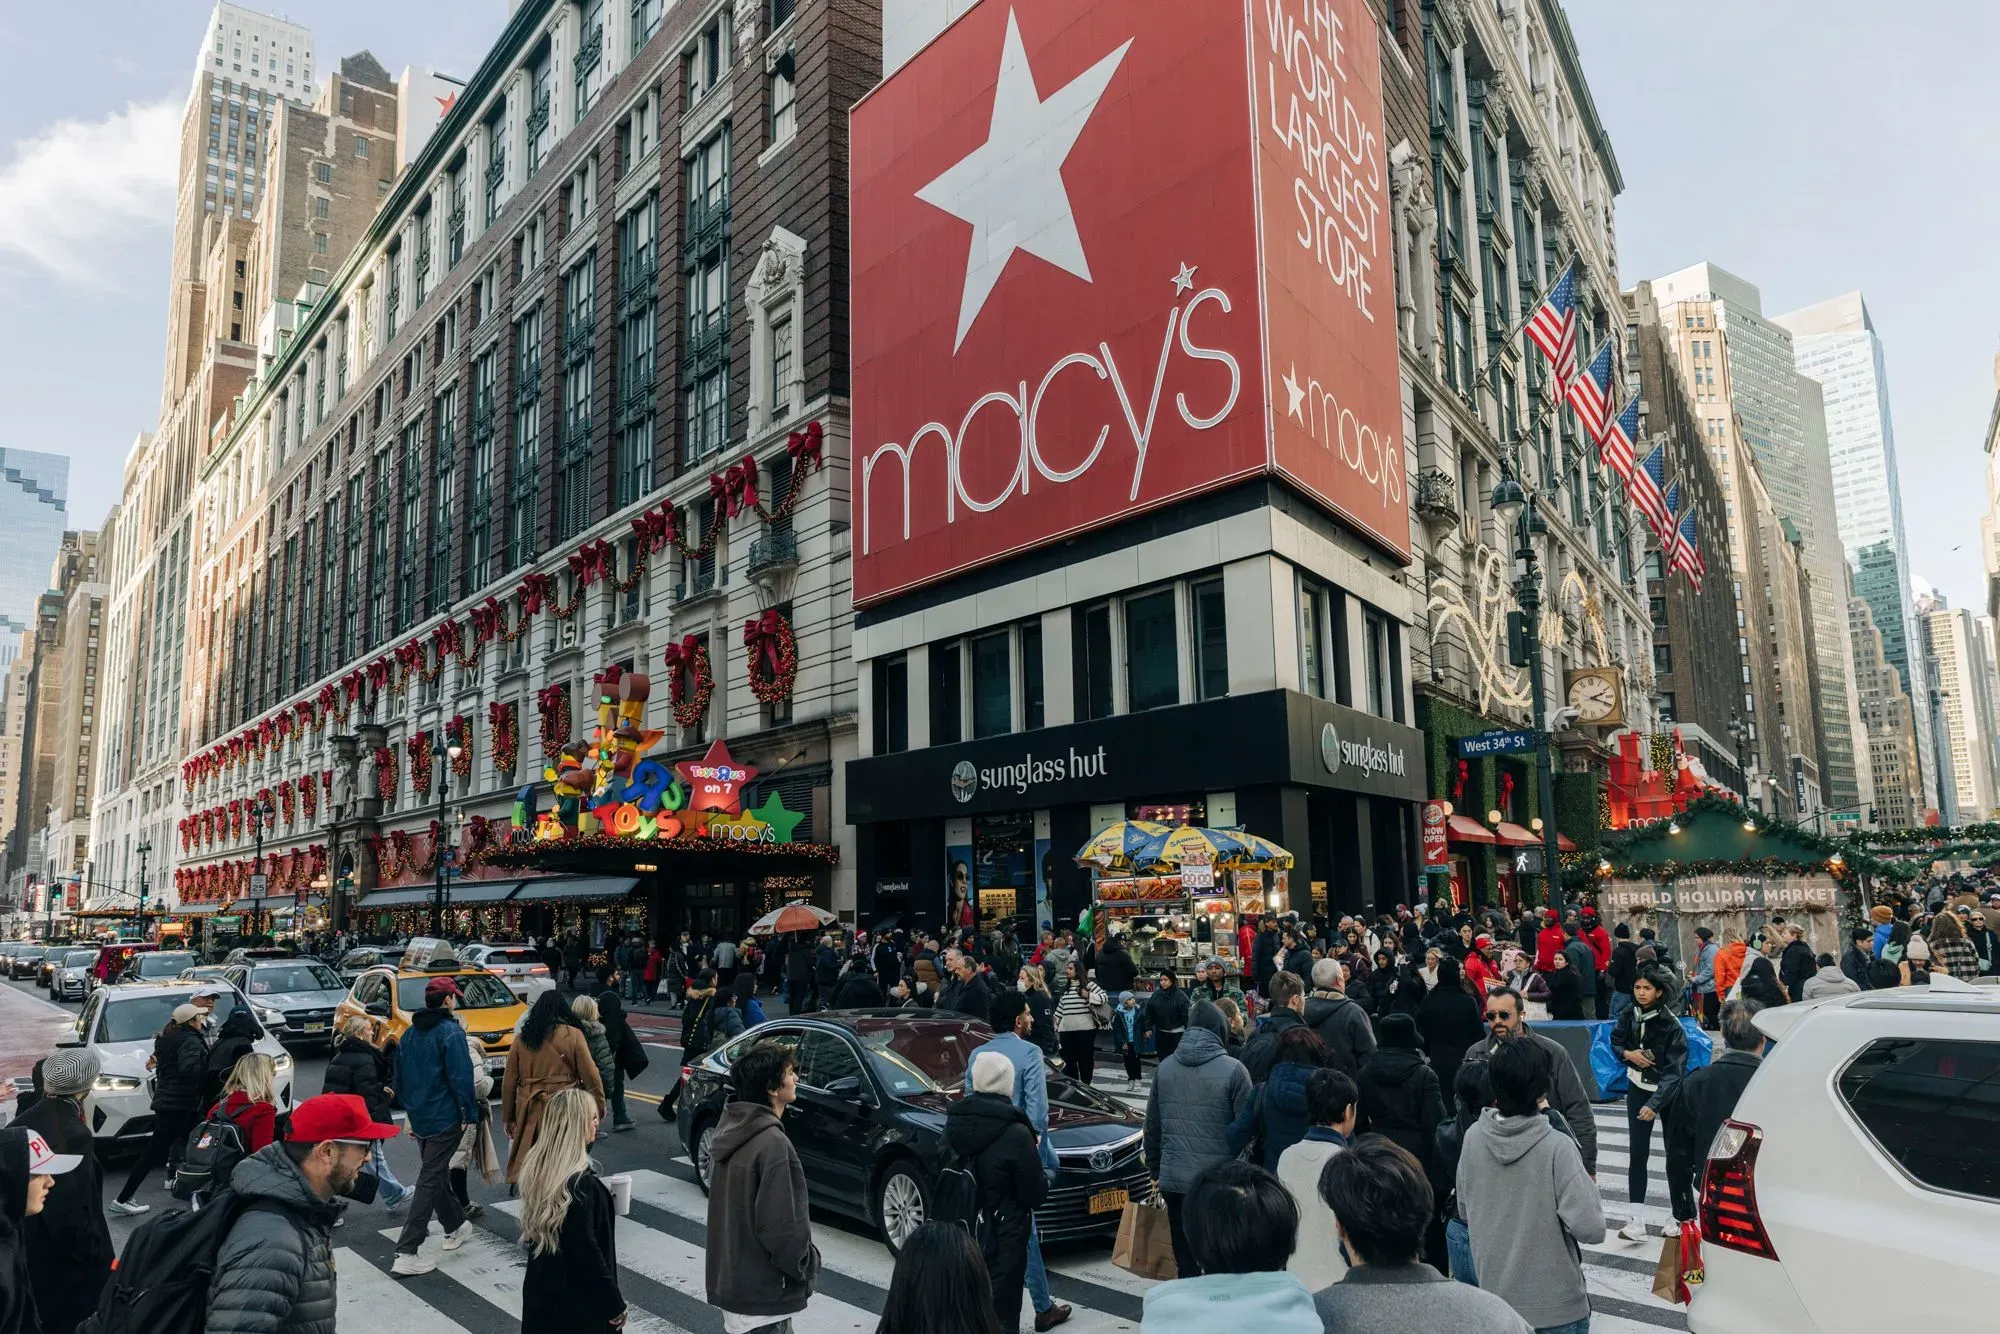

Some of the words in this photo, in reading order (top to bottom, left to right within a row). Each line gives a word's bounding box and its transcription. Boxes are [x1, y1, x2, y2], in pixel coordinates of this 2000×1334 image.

[1266, 0, 1379, 192] WORLD'S
[1269, 60, 1379, 258] LARGEST
[1294, 177, 1375, 323] STORE
[863, 262, 1240, 555] macy's
[1308, 376, 1400, 508] macy's
[1464, 740, 1491, 752] West
[1493, 736, 1512, 750] 34th
[1514, 735, 1526, 748] St
[1341, 736, 1388, 778] sunglass
[1387, 742, 1406, 777] hut
[980, 753, 1066, 795] sunglass
[1069, 745, 1108, 779] hut
[704, 784, 721, 793] on
[723, 783, 732, 794] 7
[711, 822, 776, 845] macy's
[1423, 834, 1445, 843] OPEN
[1424, 826, 1444, 835] NOW
[252, 884, 265, 892] 25
[1678, 876, 1730, 886] GREETINGS
[1732, 875, 1760, 886] FROM
[1607, 892, 1672, 905] HERALD
[1679, 888, 1757, 904] HOLIDAY
[1763, 887, 1838, 902] MARKET
